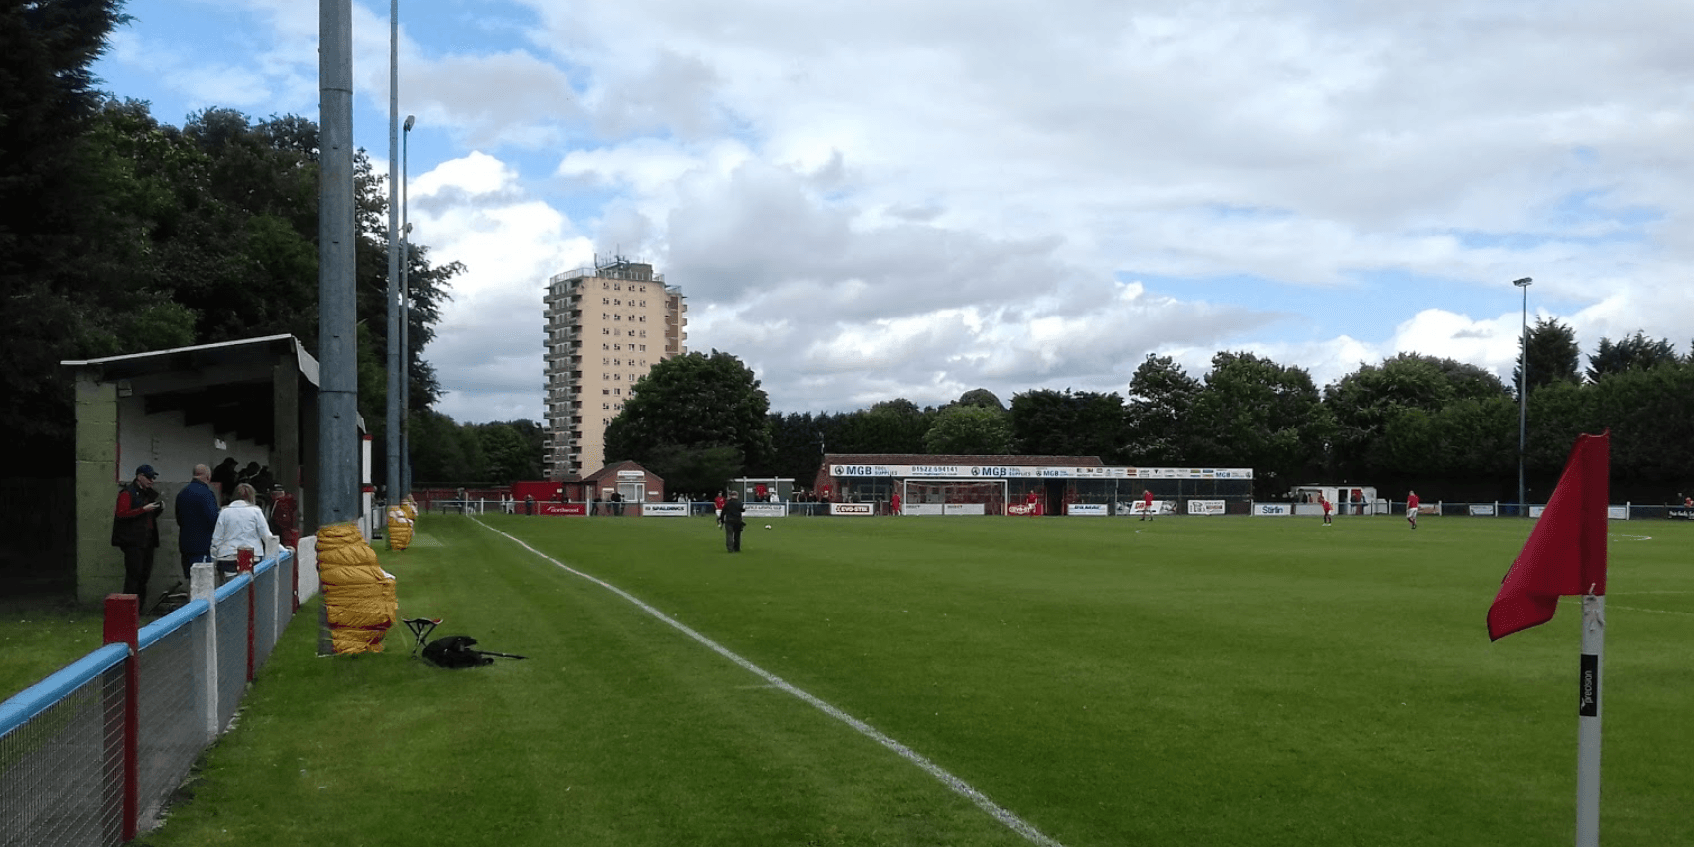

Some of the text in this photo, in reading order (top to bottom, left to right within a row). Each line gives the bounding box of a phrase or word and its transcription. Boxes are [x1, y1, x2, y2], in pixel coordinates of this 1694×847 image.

[846, 466, 872, 475] MGB
[982, 467, 1007, 476] MGB
[1584, 670, 1594, 704] precision
